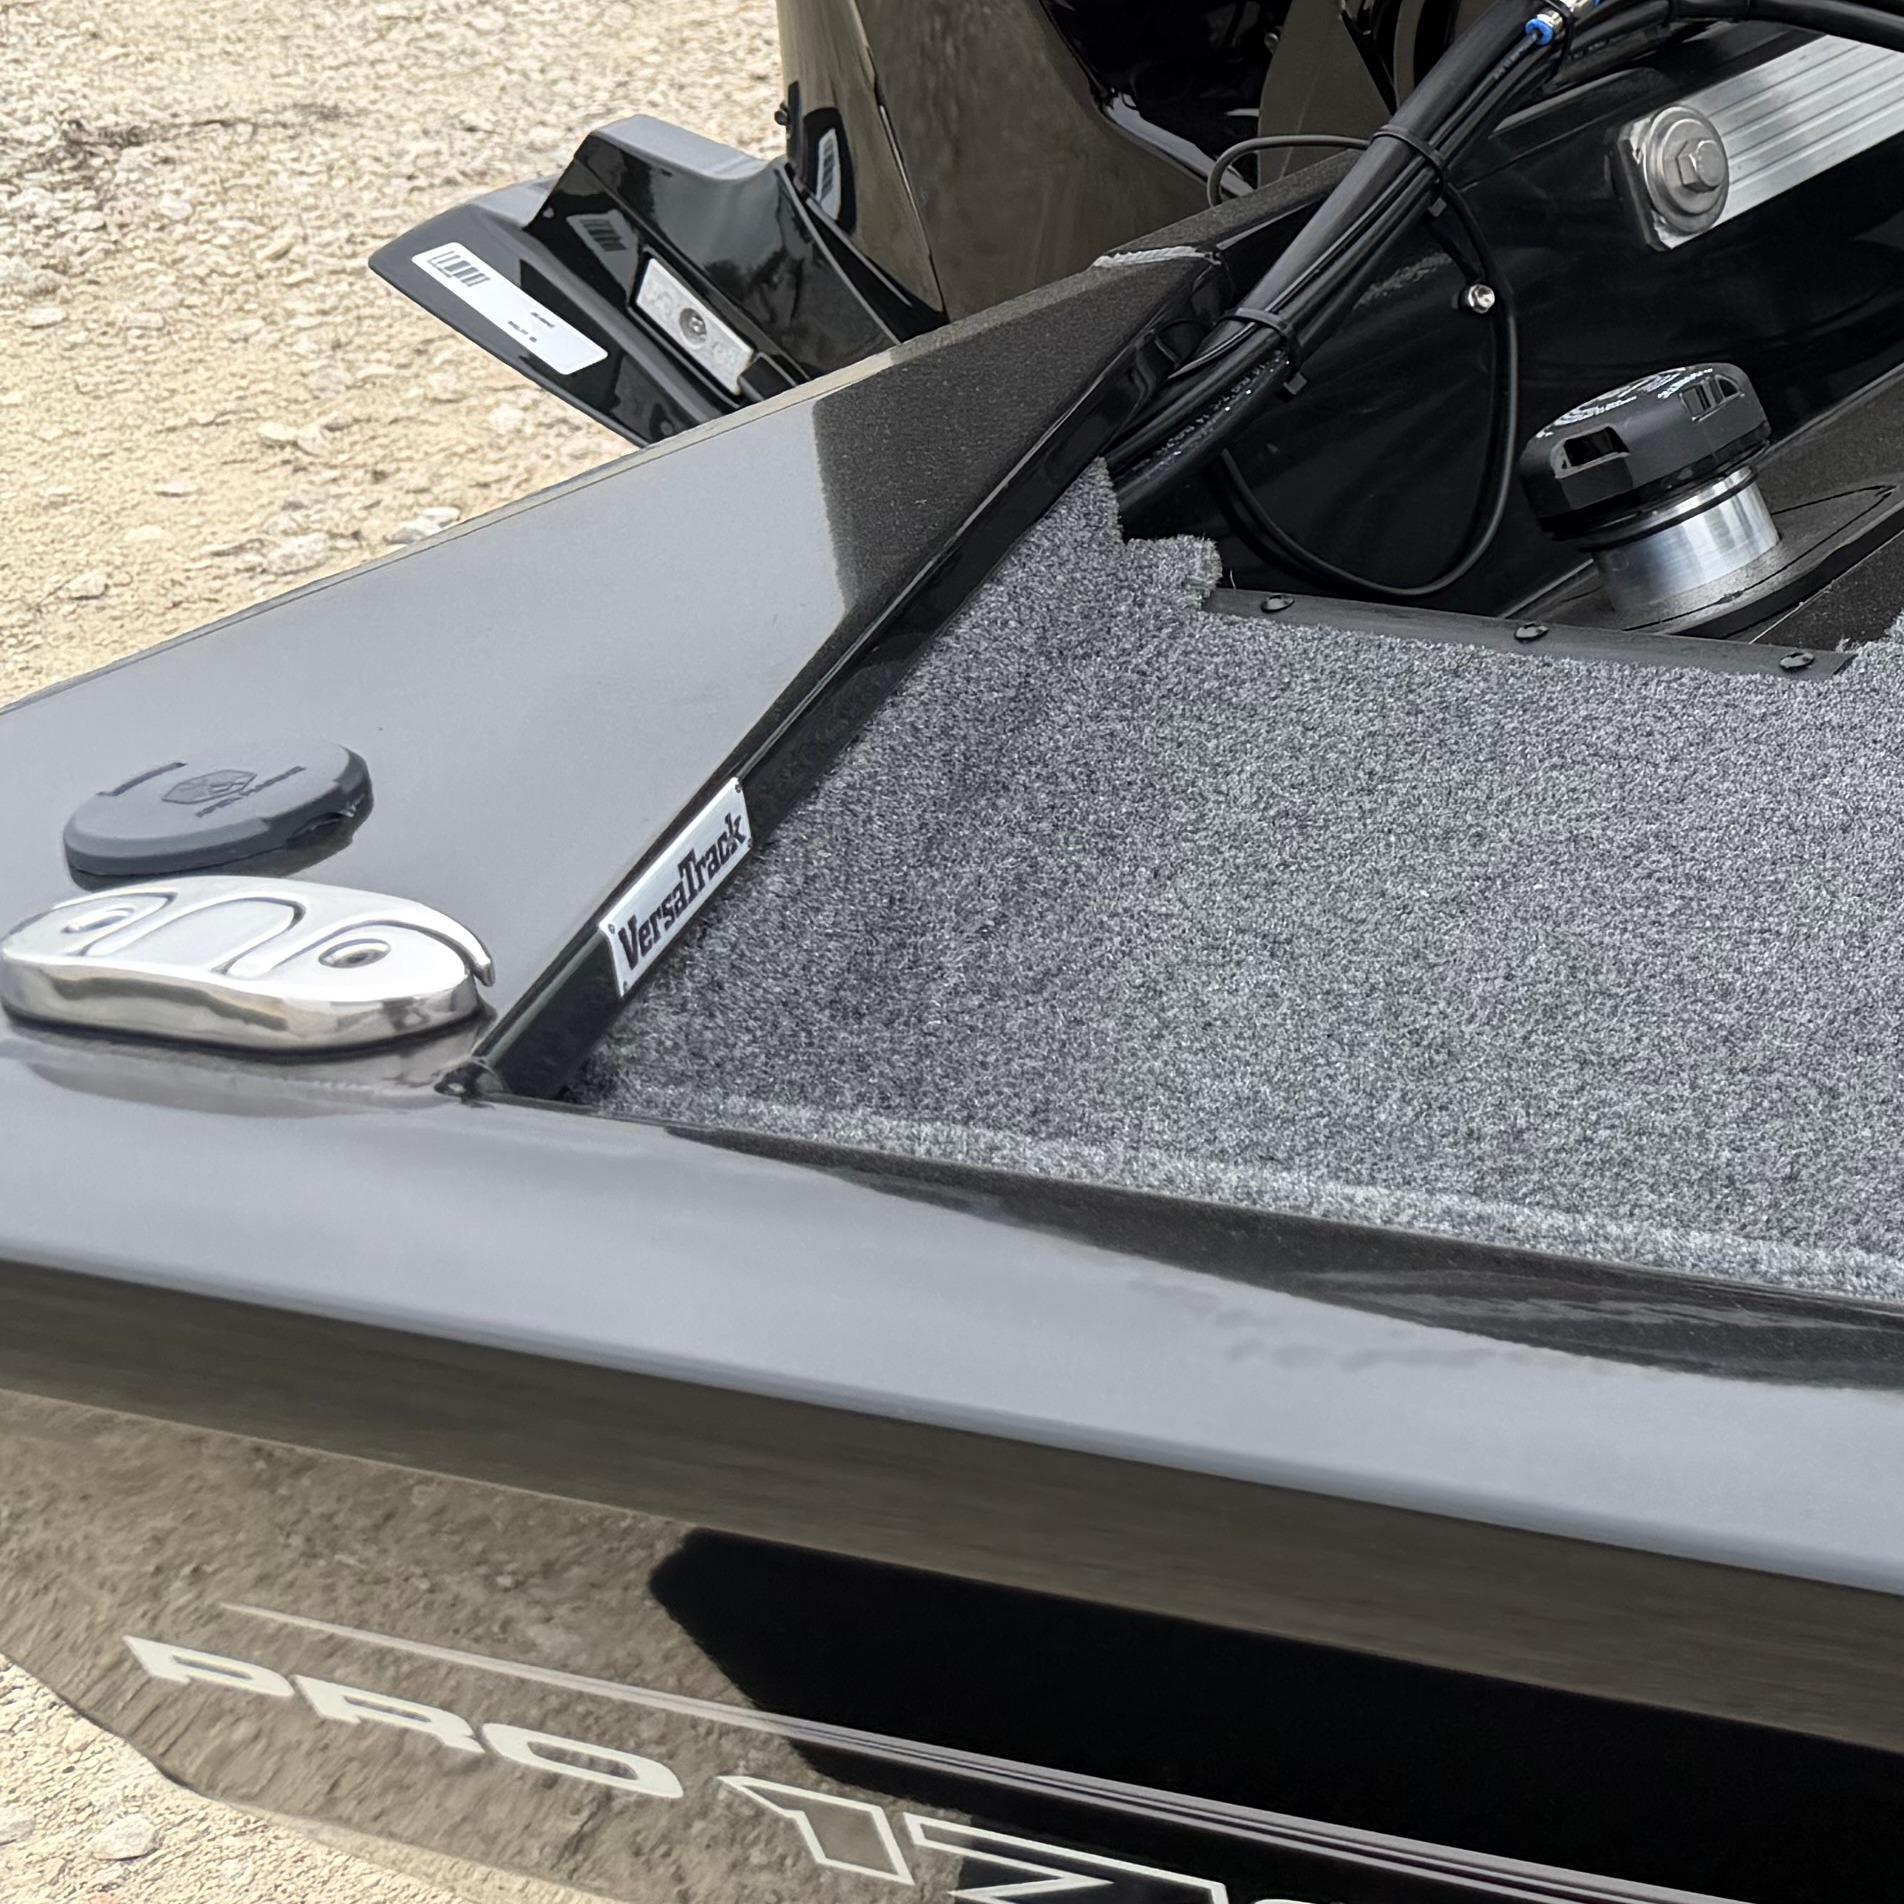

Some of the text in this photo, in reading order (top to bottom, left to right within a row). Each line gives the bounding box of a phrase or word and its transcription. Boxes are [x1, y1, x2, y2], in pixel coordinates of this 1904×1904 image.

[617, 812, 746, 971] VersaTrack
[123, 1635, 1328, 1904] PRO 17
